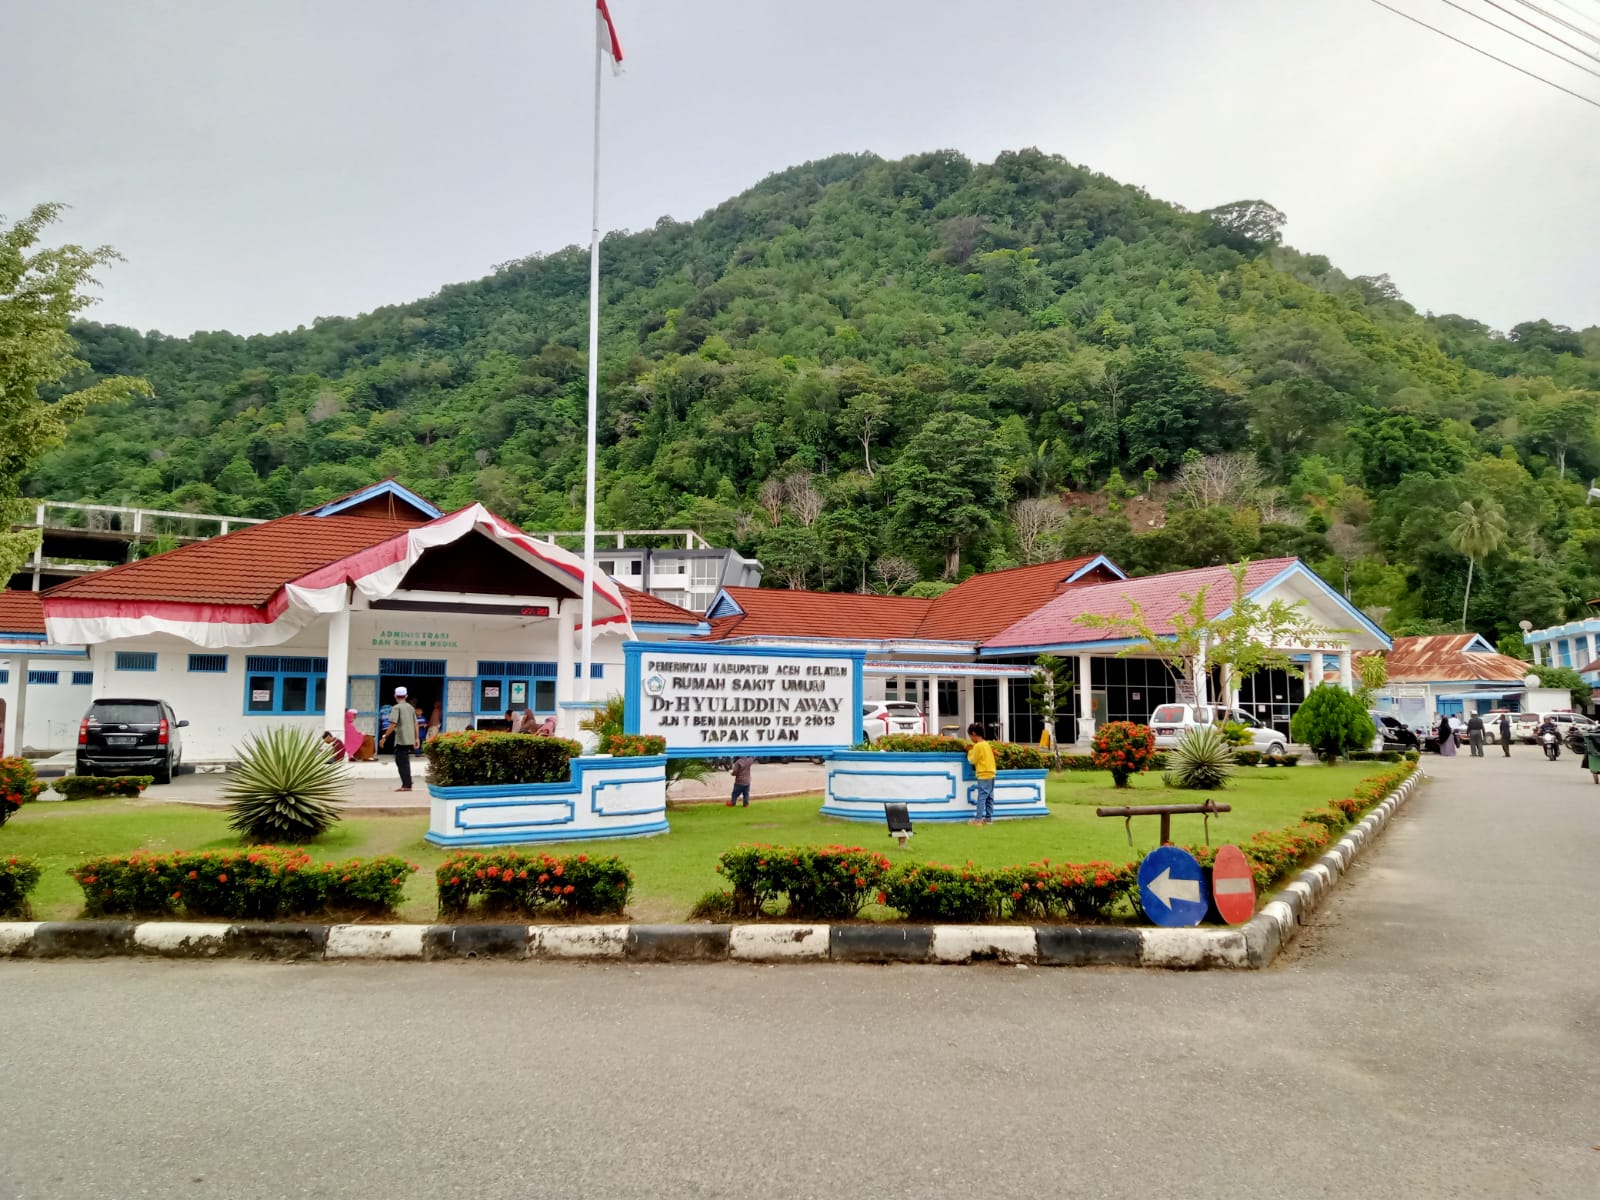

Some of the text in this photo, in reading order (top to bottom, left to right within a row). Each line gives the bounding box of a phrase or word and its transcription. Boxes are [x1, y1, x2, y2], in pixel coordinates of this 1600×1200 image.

[380, 630, 449, 639] ADMINISTRASI
[648, 661, 848, 677] PEMERINTAH KABUPATEN ACEH SELATAN
[672, 677, 826, 692] RUMAH SAKIT UMUM
[793, 697, 843, 713] AWAY
[659, 714, 836, 727] JLN T BEN MAHMUD TELP 21013
[700, 728, 799, 742] TAPAK TUAN
